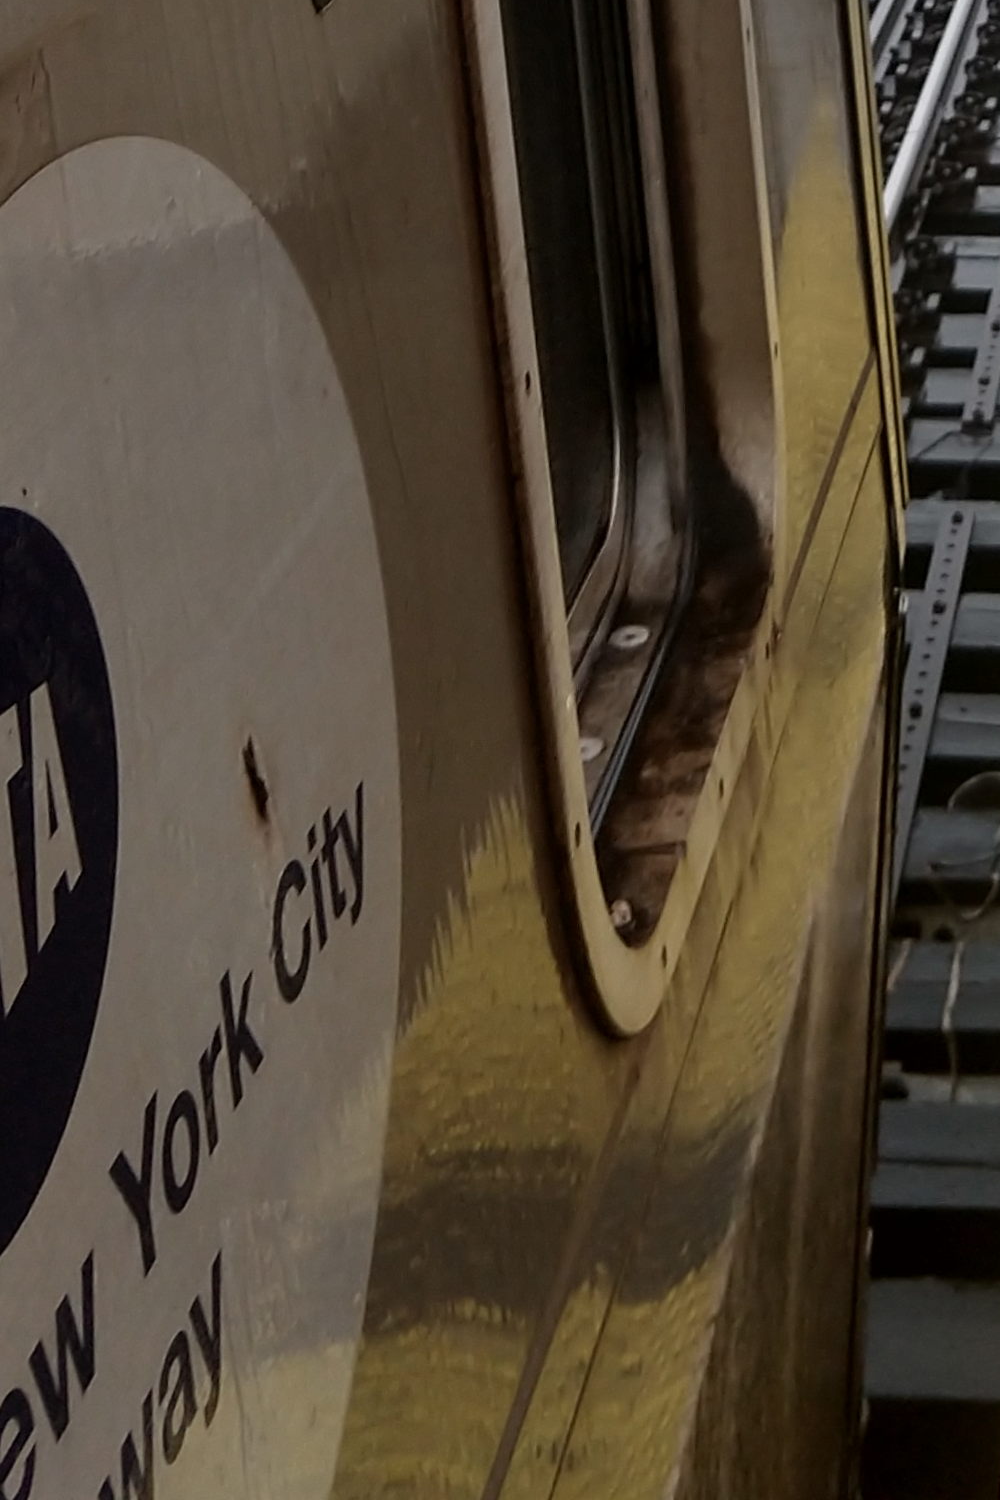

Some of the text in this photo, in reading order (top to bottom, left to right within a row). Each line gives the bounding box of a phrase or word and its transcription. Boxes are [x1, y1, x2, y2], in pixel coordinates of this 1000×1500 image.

[0, 679, 84, 1017] TA
[0, 779, 364, 1500] ew York City
[97, 1248, 222, 1500] way
